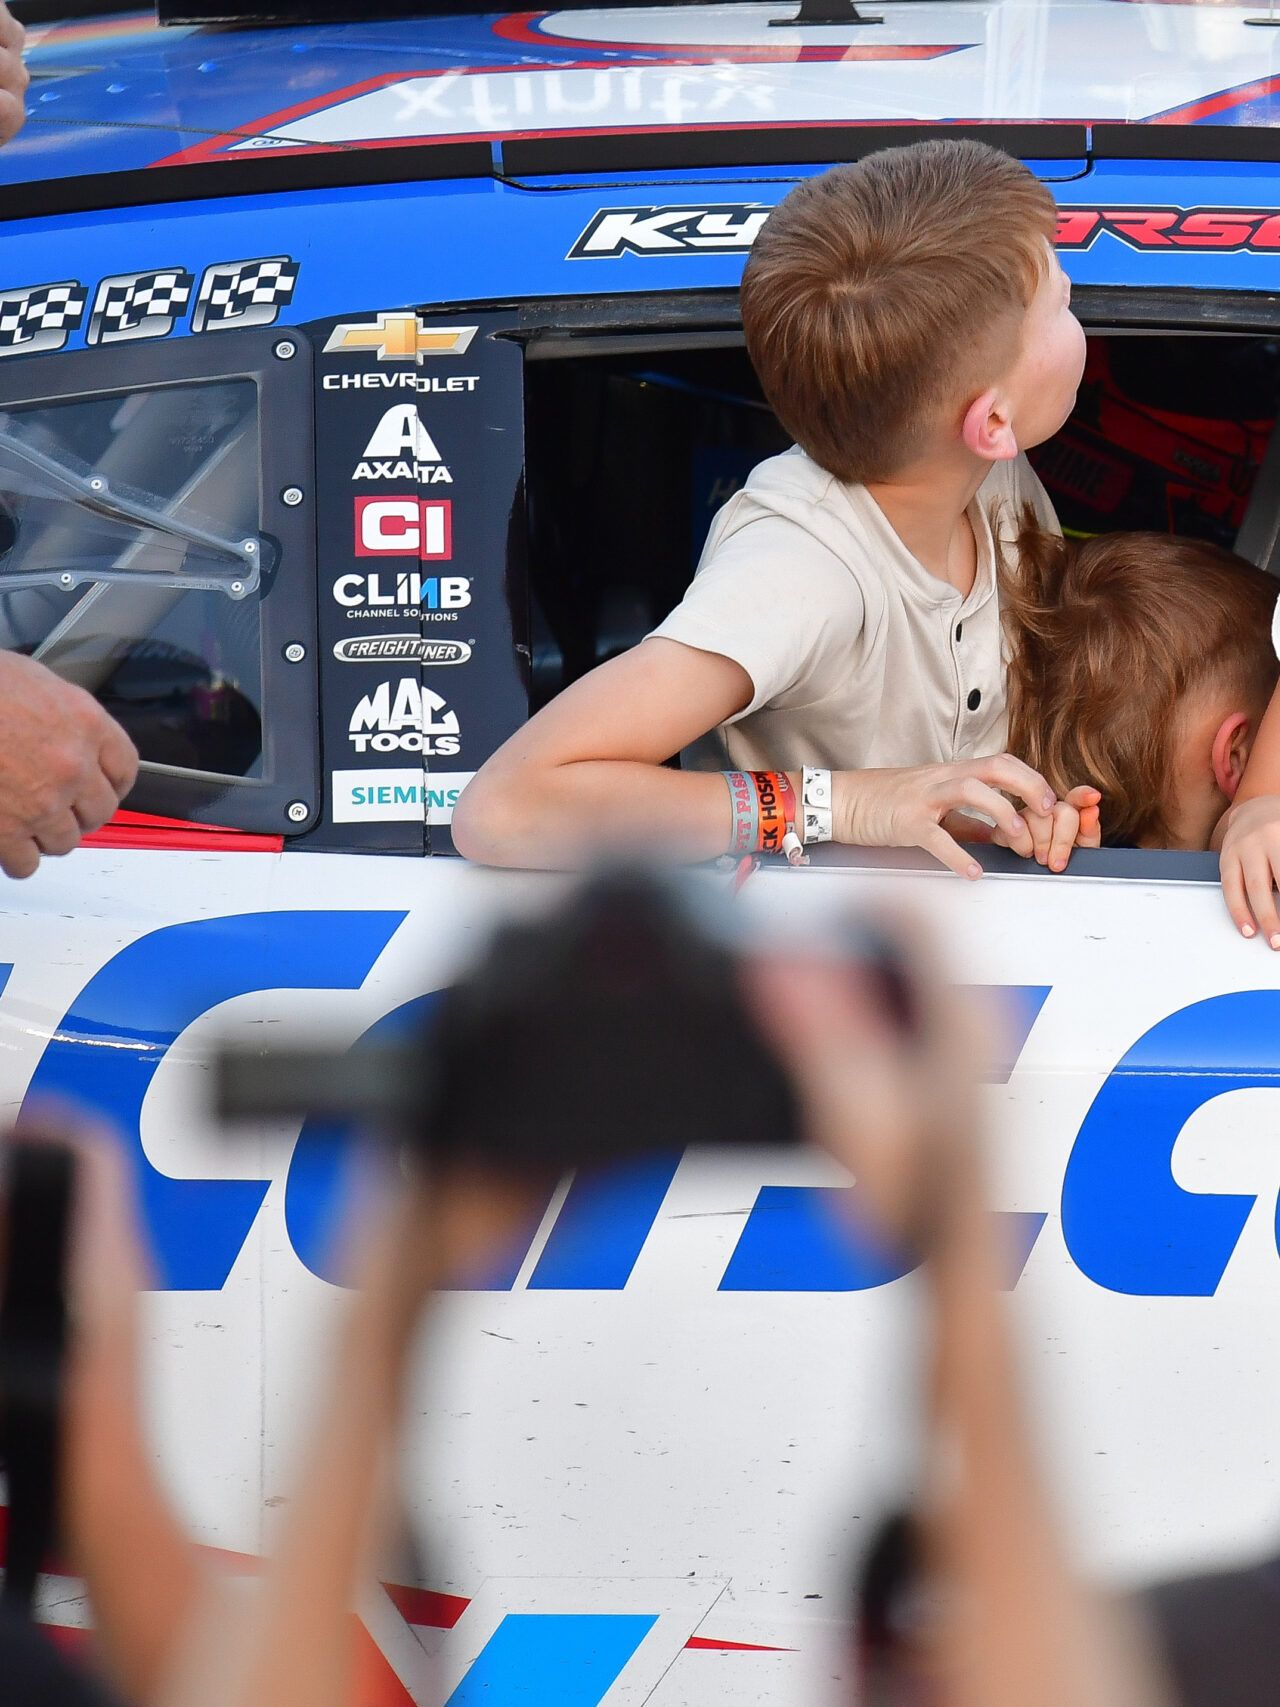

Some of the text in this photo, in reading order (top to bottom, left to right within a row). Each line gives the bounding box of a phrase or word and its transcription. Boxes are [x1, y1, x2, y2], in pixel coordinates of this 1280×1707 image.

[322, 372, 481, 393] CHEVROLET
[361, 501, 446, 554] CI
[332, 573, 472, 609] CLIMB
[346, 608, 400, 618] CHANNEL
[348, 677, 460, 735] MAC
[348, 732, 461, 756] TOOLS
